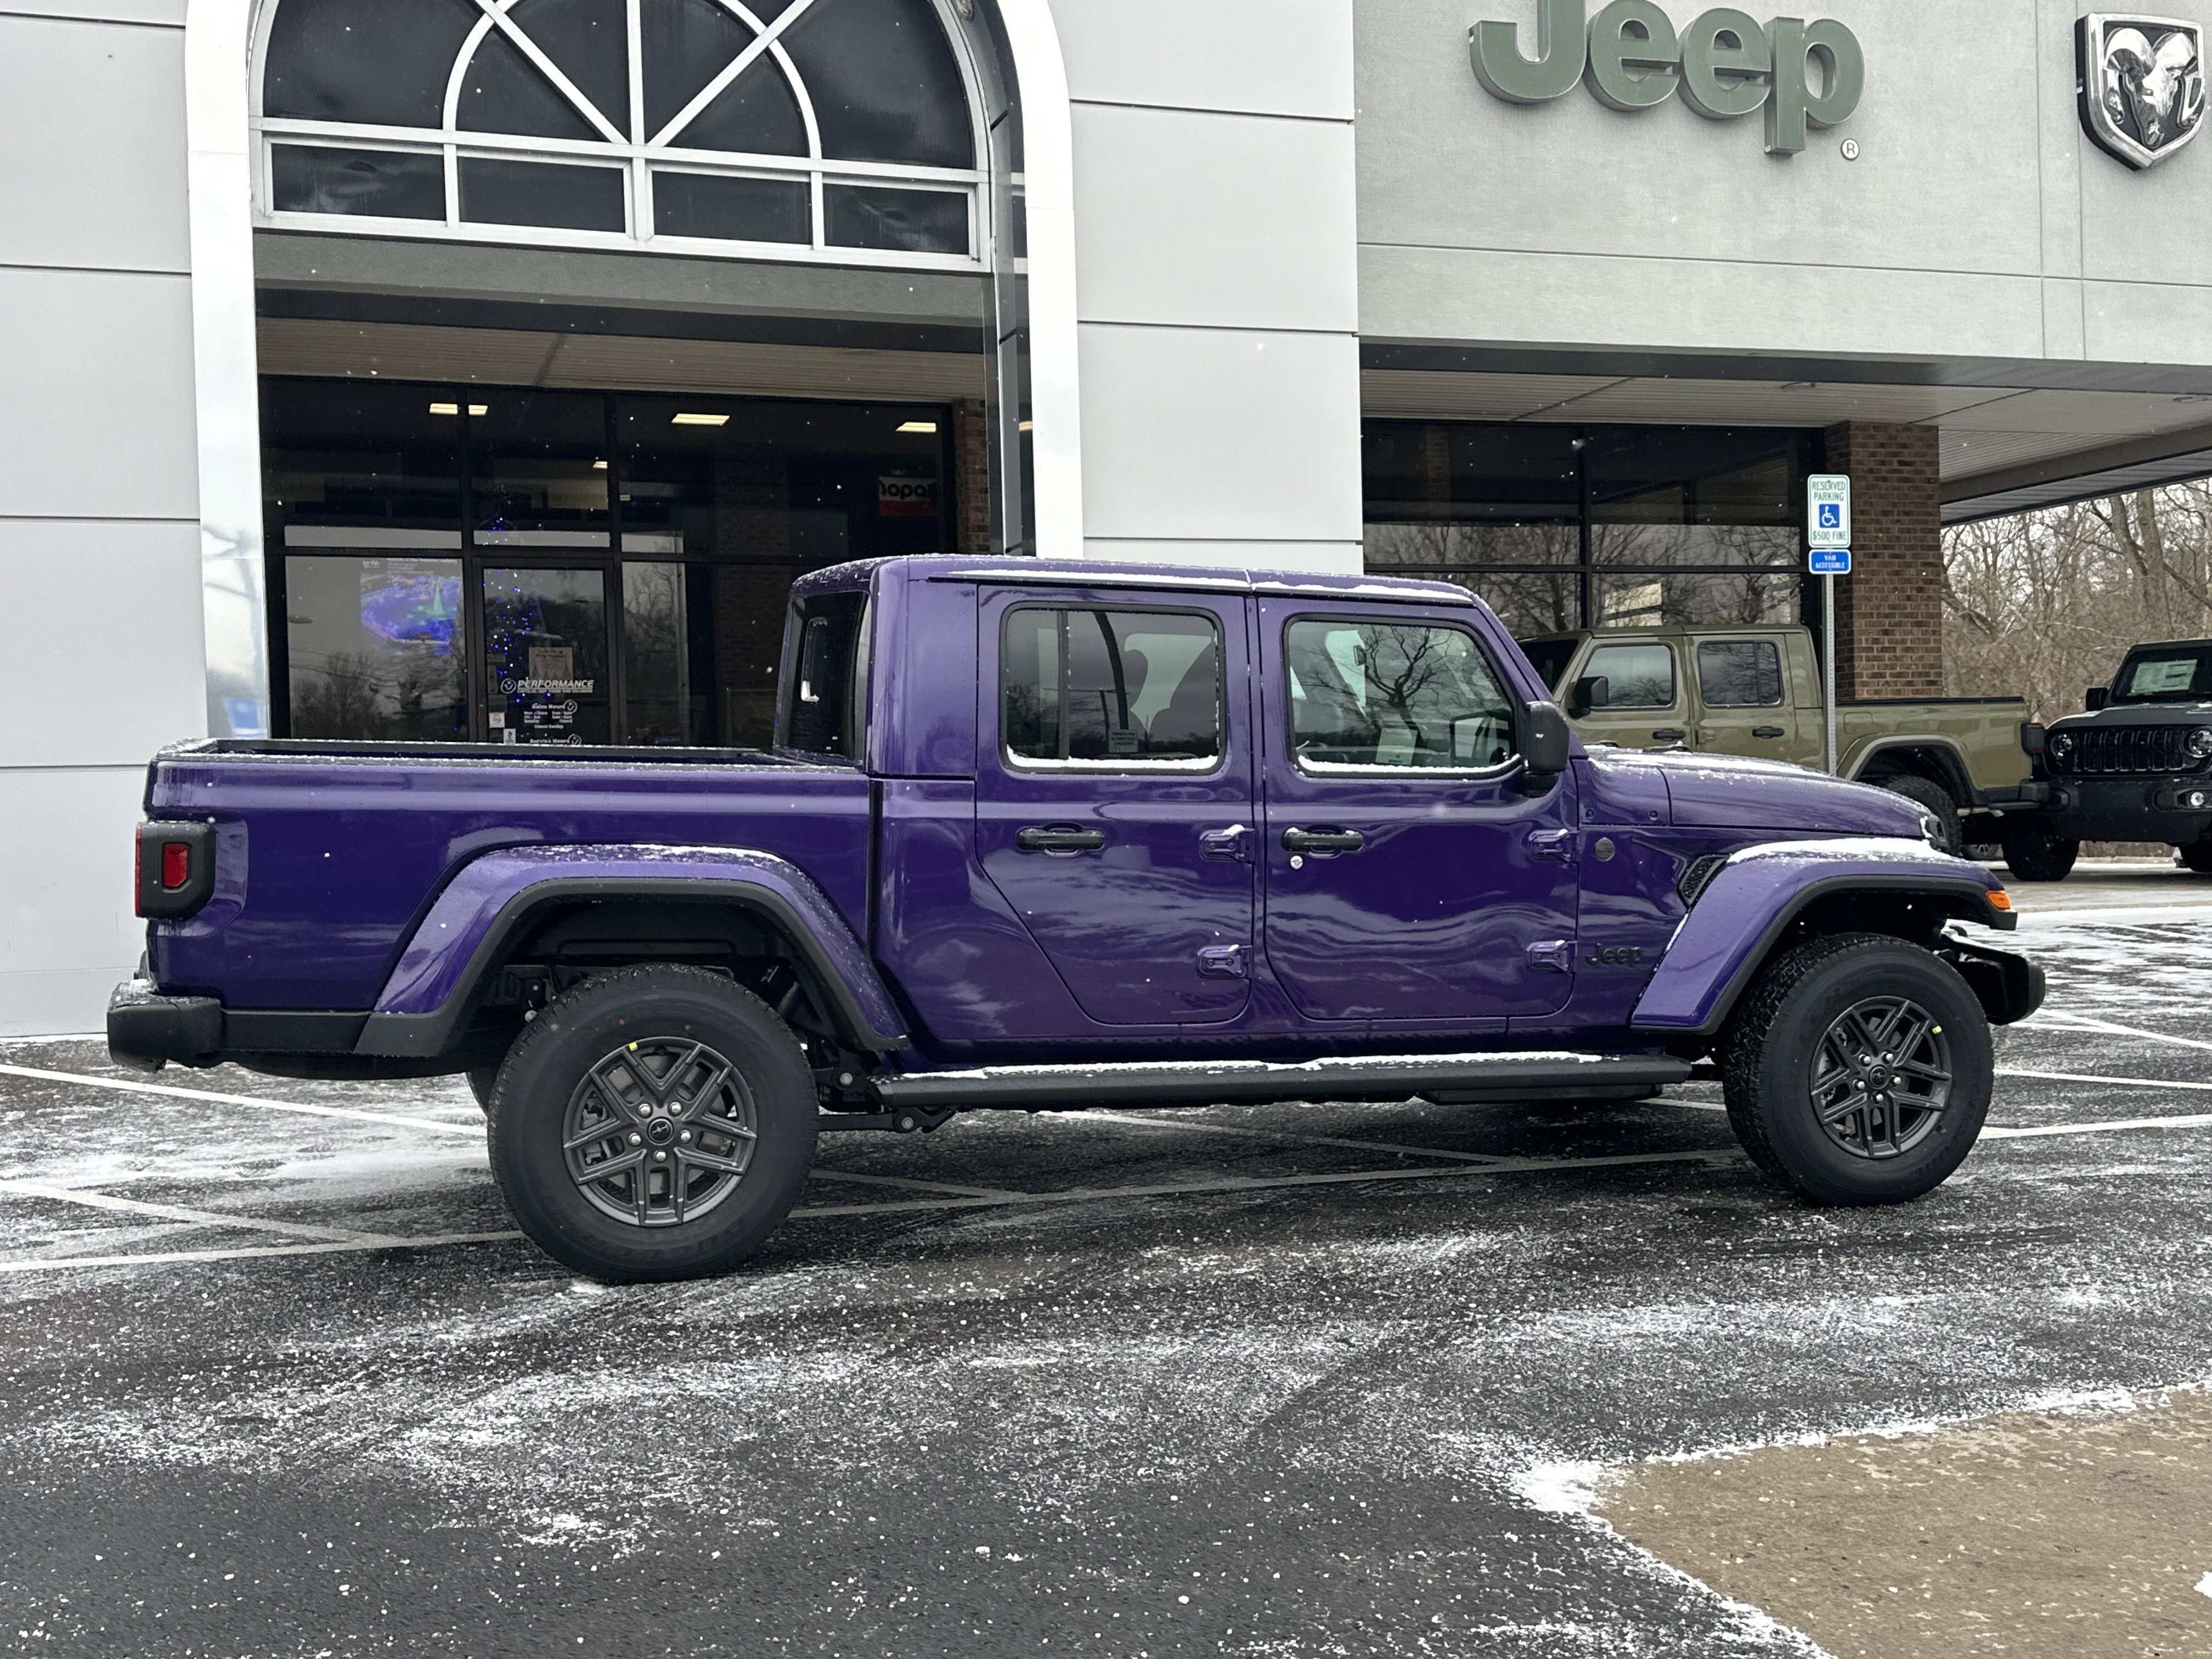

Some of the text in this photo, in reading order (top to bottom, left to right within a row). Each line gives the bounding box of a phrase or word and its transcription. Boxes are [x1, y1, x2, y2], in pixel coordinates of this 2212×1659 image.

[1469, 0, 1865, 155] Jeep
[1812, 481, 1846, 490] RESERVED
[1814, 492, 1844, 501] PARKING
[1813, 531, 1847, 541] $500 FINE
[1585, 943, 1641, 967] Jeep
